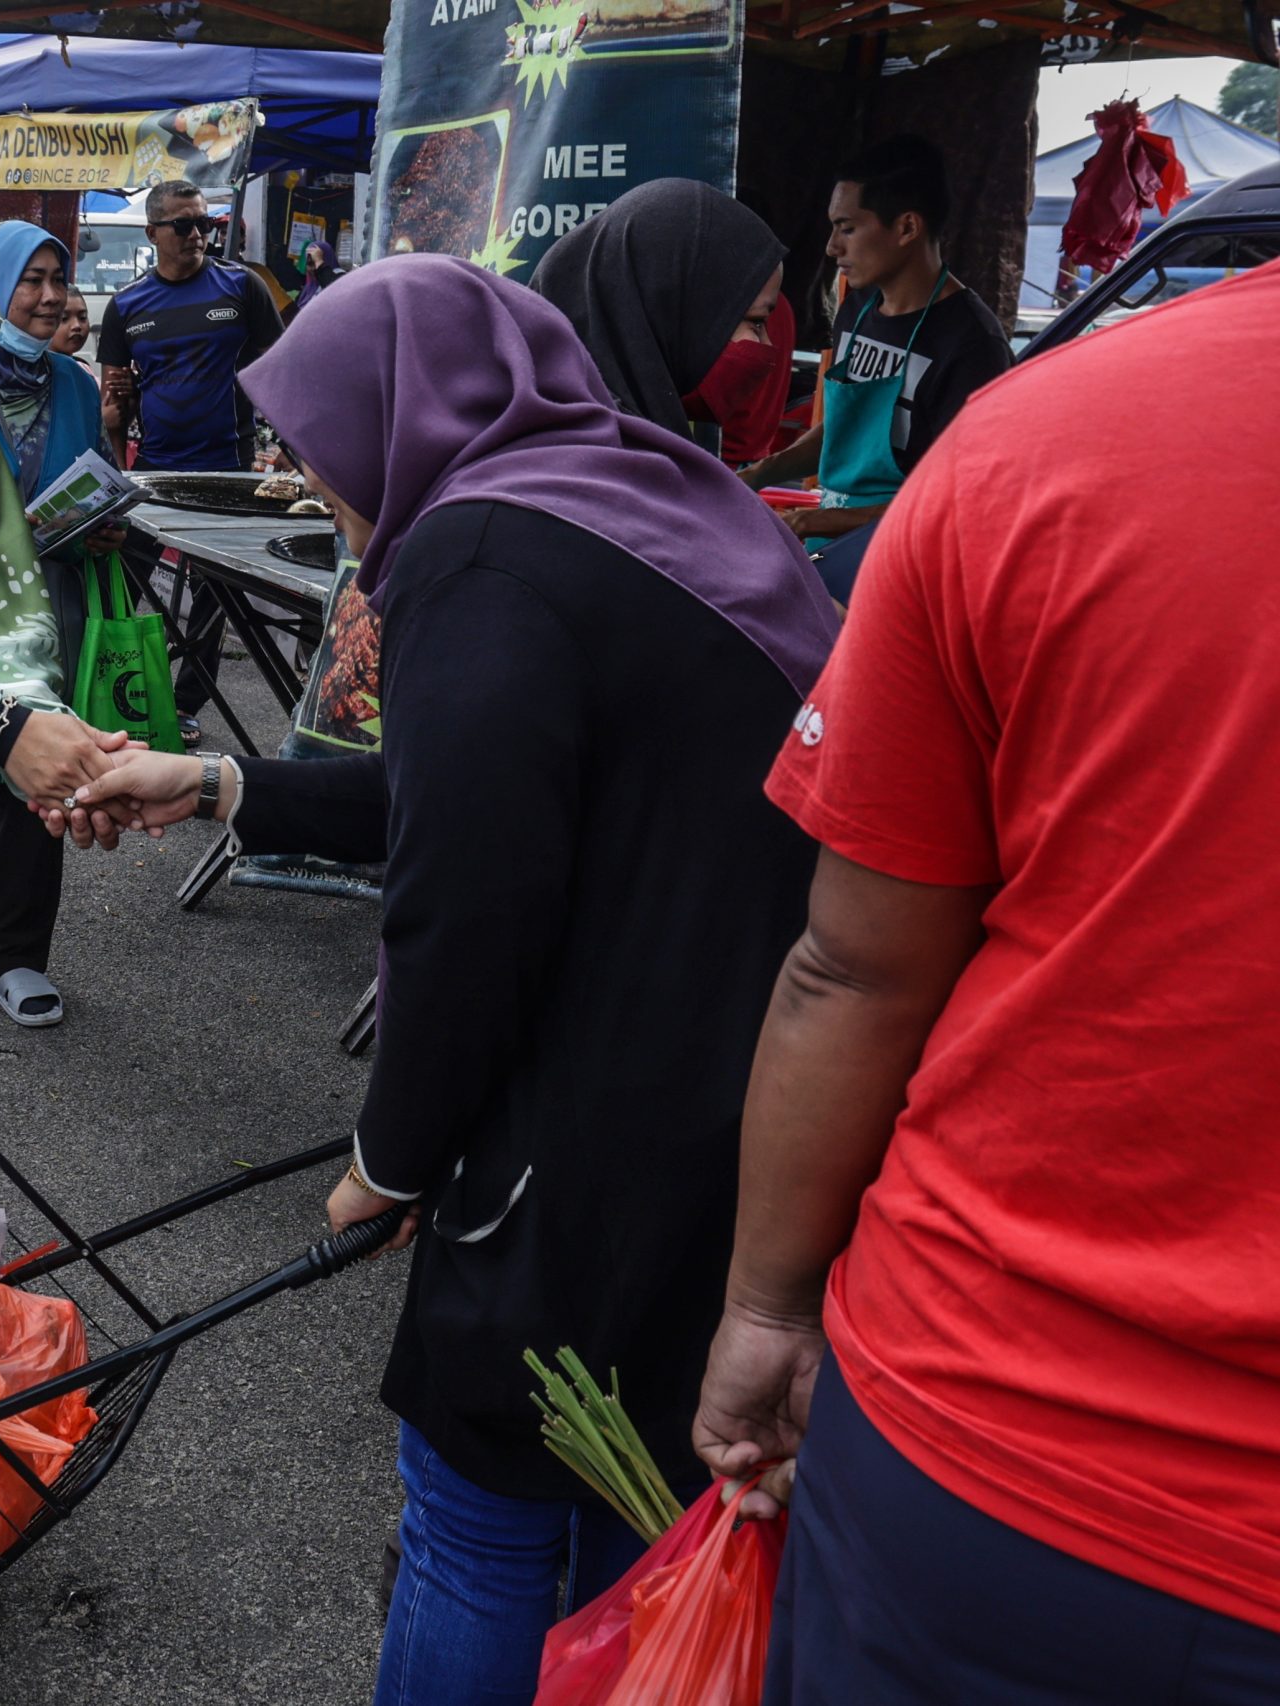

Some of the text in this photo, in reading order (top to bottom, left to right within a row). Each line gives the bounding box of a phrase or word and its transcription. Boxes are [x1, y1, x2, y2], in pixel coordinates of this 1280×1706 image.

[13, 125, 71, 158] DENBU
[73, 122, 129, 156] SUSHI
[32, 168, 111, 183] SINCE 2012
[543, 143, 627, 179] MEE
[848, 340, 905, 380] RIDAY
